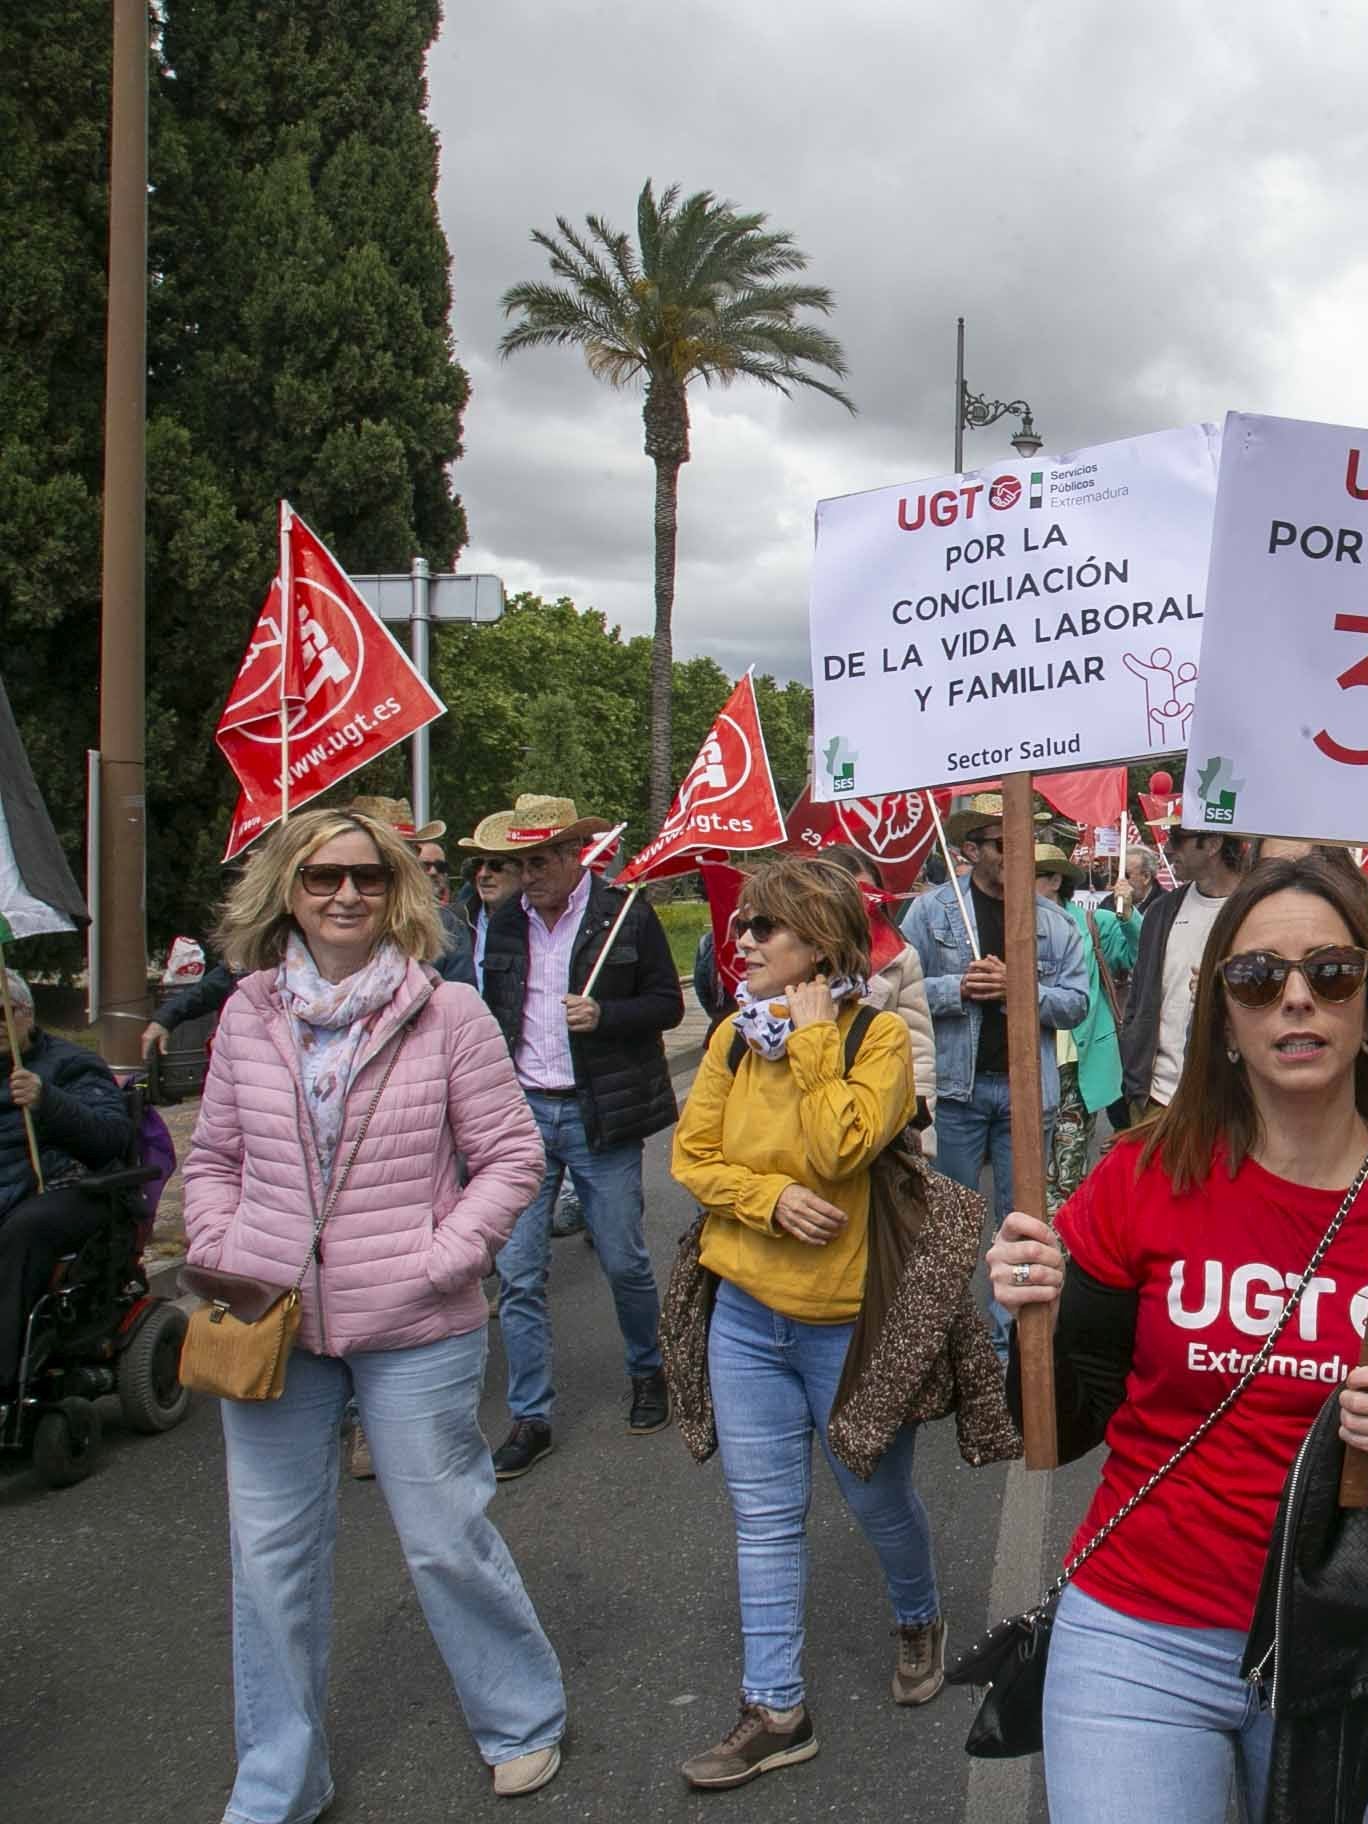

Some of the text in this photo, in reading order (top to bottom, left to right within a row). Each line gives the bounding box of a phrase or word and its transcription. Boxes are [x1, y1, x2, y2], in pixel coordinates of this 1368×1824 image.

[1051, 464, 1098, 480] Servicios
[1051, 479, 1095, 493] Públicos
[898, 484, 984, 531] UGT
[1051, 486, 1129, 508] Extremadura
[946, 524, 1067, 571] POR LA
[1268, 520, 1363, 564] POR
[893, 556, 1129, 624] CONCILIACIÓN
[824, 594, 1204, 681] DE LA VIDA LABORAL
[915, 656, 1105, 712] Y FAMILIAR
[274, 696, 401, 790] www.ugt.es
[947, 734, 1081, 771] Sector Salud
[834, 777, 854, 791] SES
[1206, 806, 1233, 822] SES
[1168, 1260, 1335, 1342] UGT
[1188, 1343, 1348, 1384] Extremad
